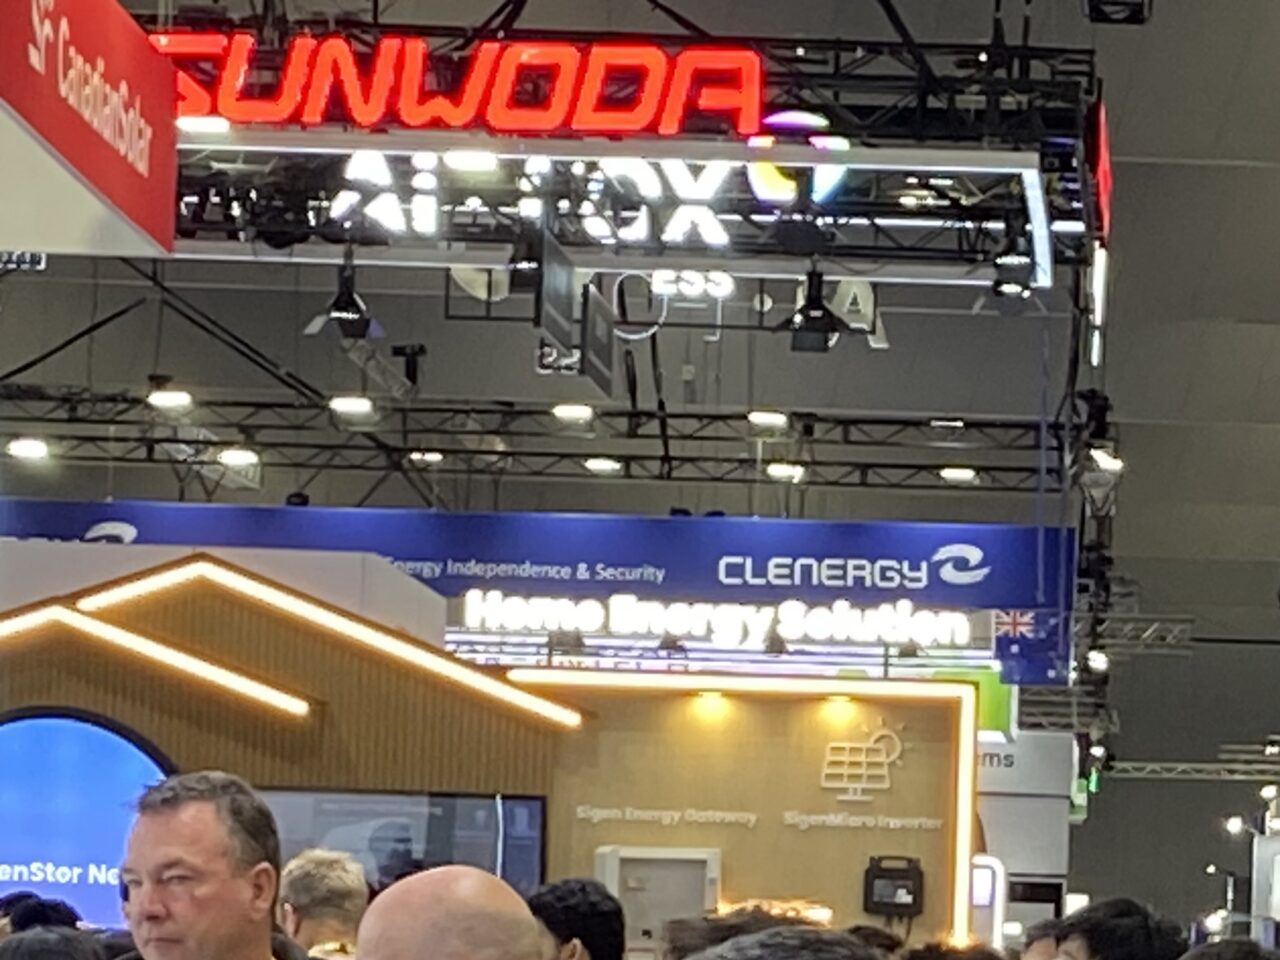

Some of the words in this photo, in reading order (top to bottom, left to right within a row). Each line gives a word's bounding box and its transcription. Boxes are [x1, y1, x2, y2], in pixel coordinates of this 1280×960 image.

[446, 558, 572, 580] Independence
[576, 562, 590, 580] &
[595, 563, 666, 585] Security
[717, 555, 929, 590] CLENERGY
[464, 588, 606, 633] Home
[608, 593, 775, 647] Energy
[776, 598, 971, 645] Solution
[625, 806, 681, 825] Energy
